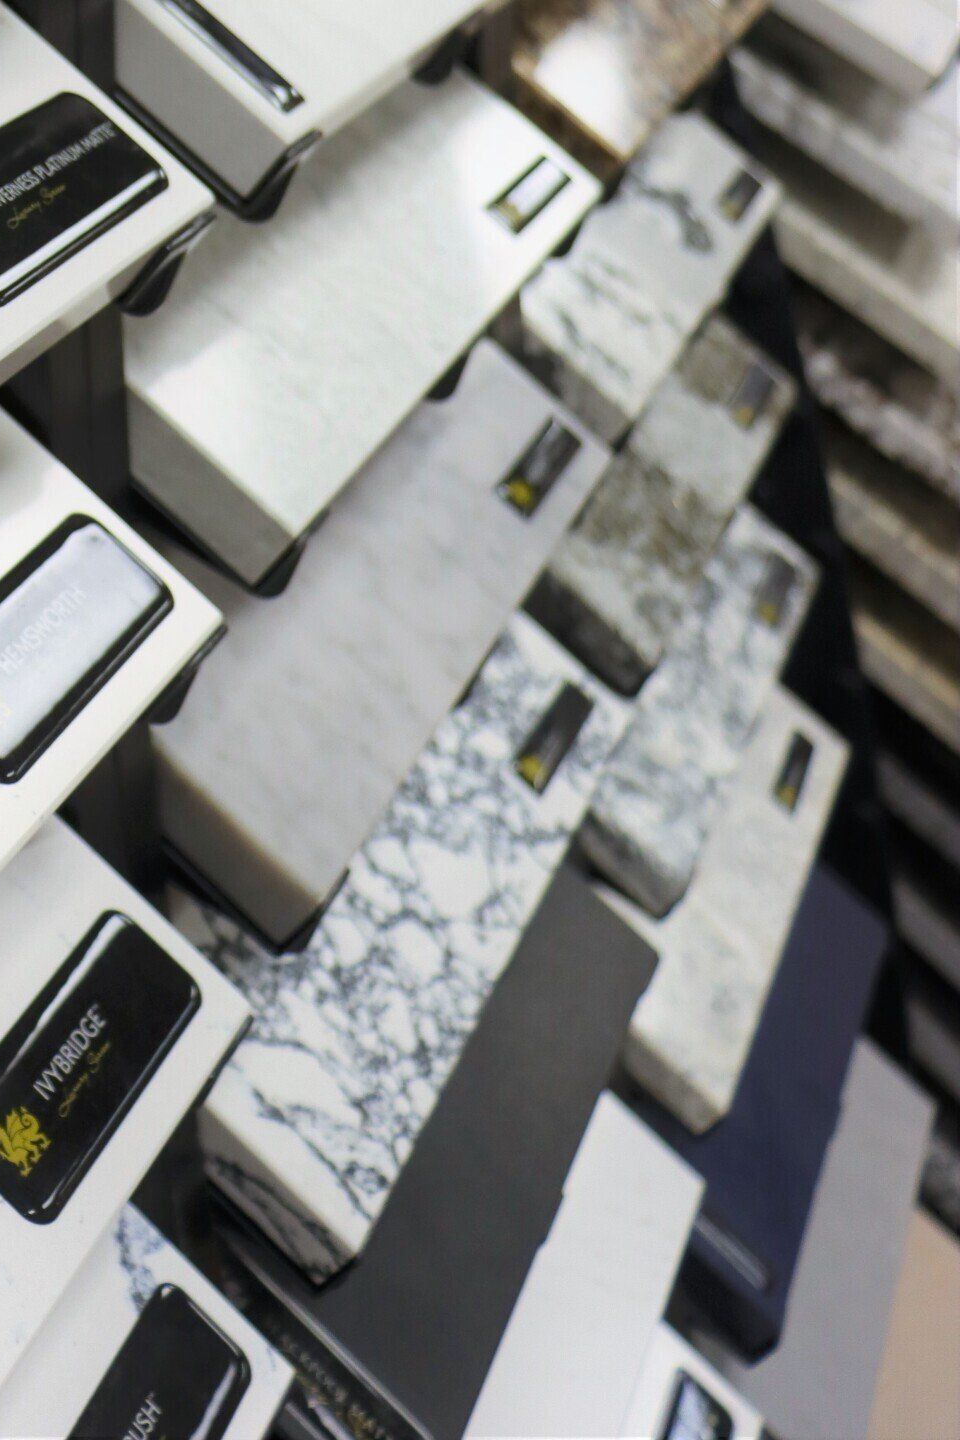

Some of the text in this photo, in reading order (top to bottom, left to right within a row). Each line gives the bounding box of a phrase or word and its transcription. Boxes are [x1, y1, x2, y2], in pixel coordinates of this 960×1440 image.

[33, 143, 86, 181] PLATINUM
[80, 120, 116, 149] MATTE
[33, 1006, 107, 1101] IVYBRIDGE
